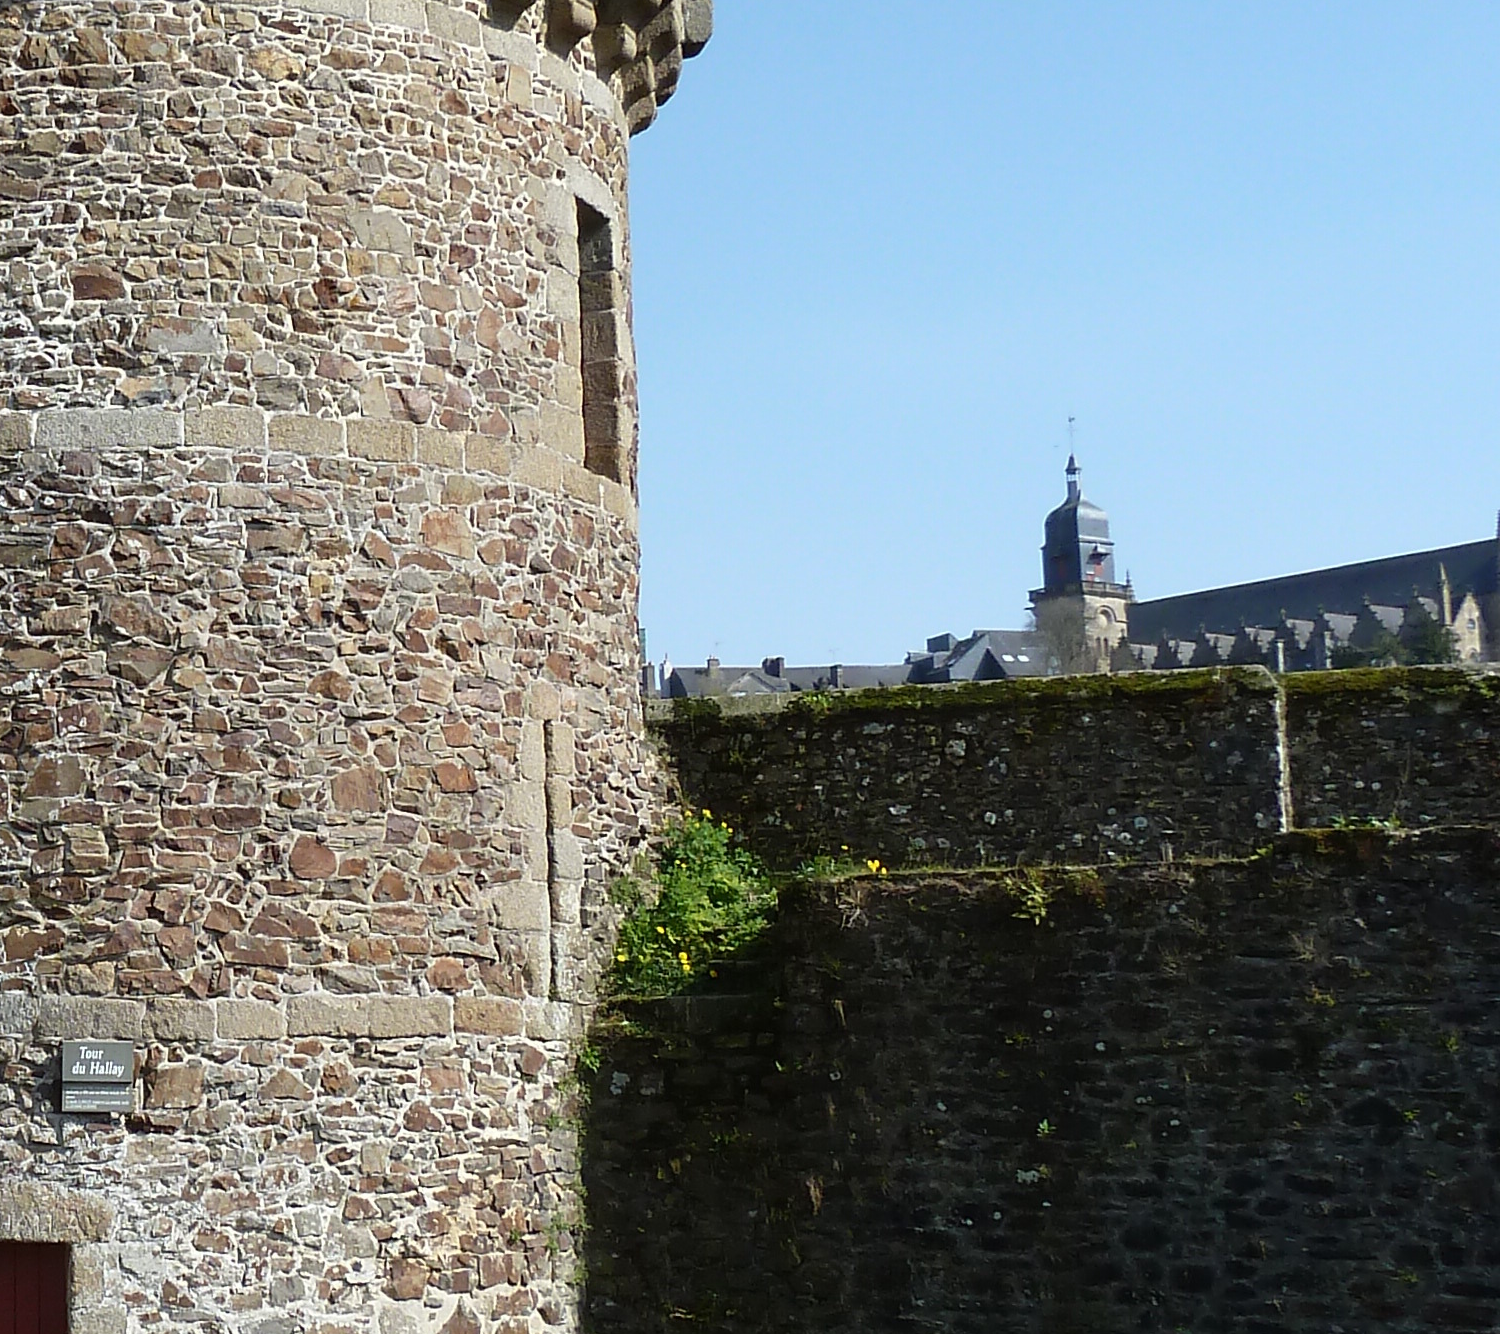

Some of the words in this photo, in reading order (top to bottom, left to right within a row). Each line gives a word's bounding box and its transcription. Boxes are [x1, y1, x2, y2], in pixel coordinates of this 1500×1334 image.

[79, 1046, 103, 1059] Tour
[72, 1062, 86, 1075] du
[90, 1061, 125, 1078] Hallay
